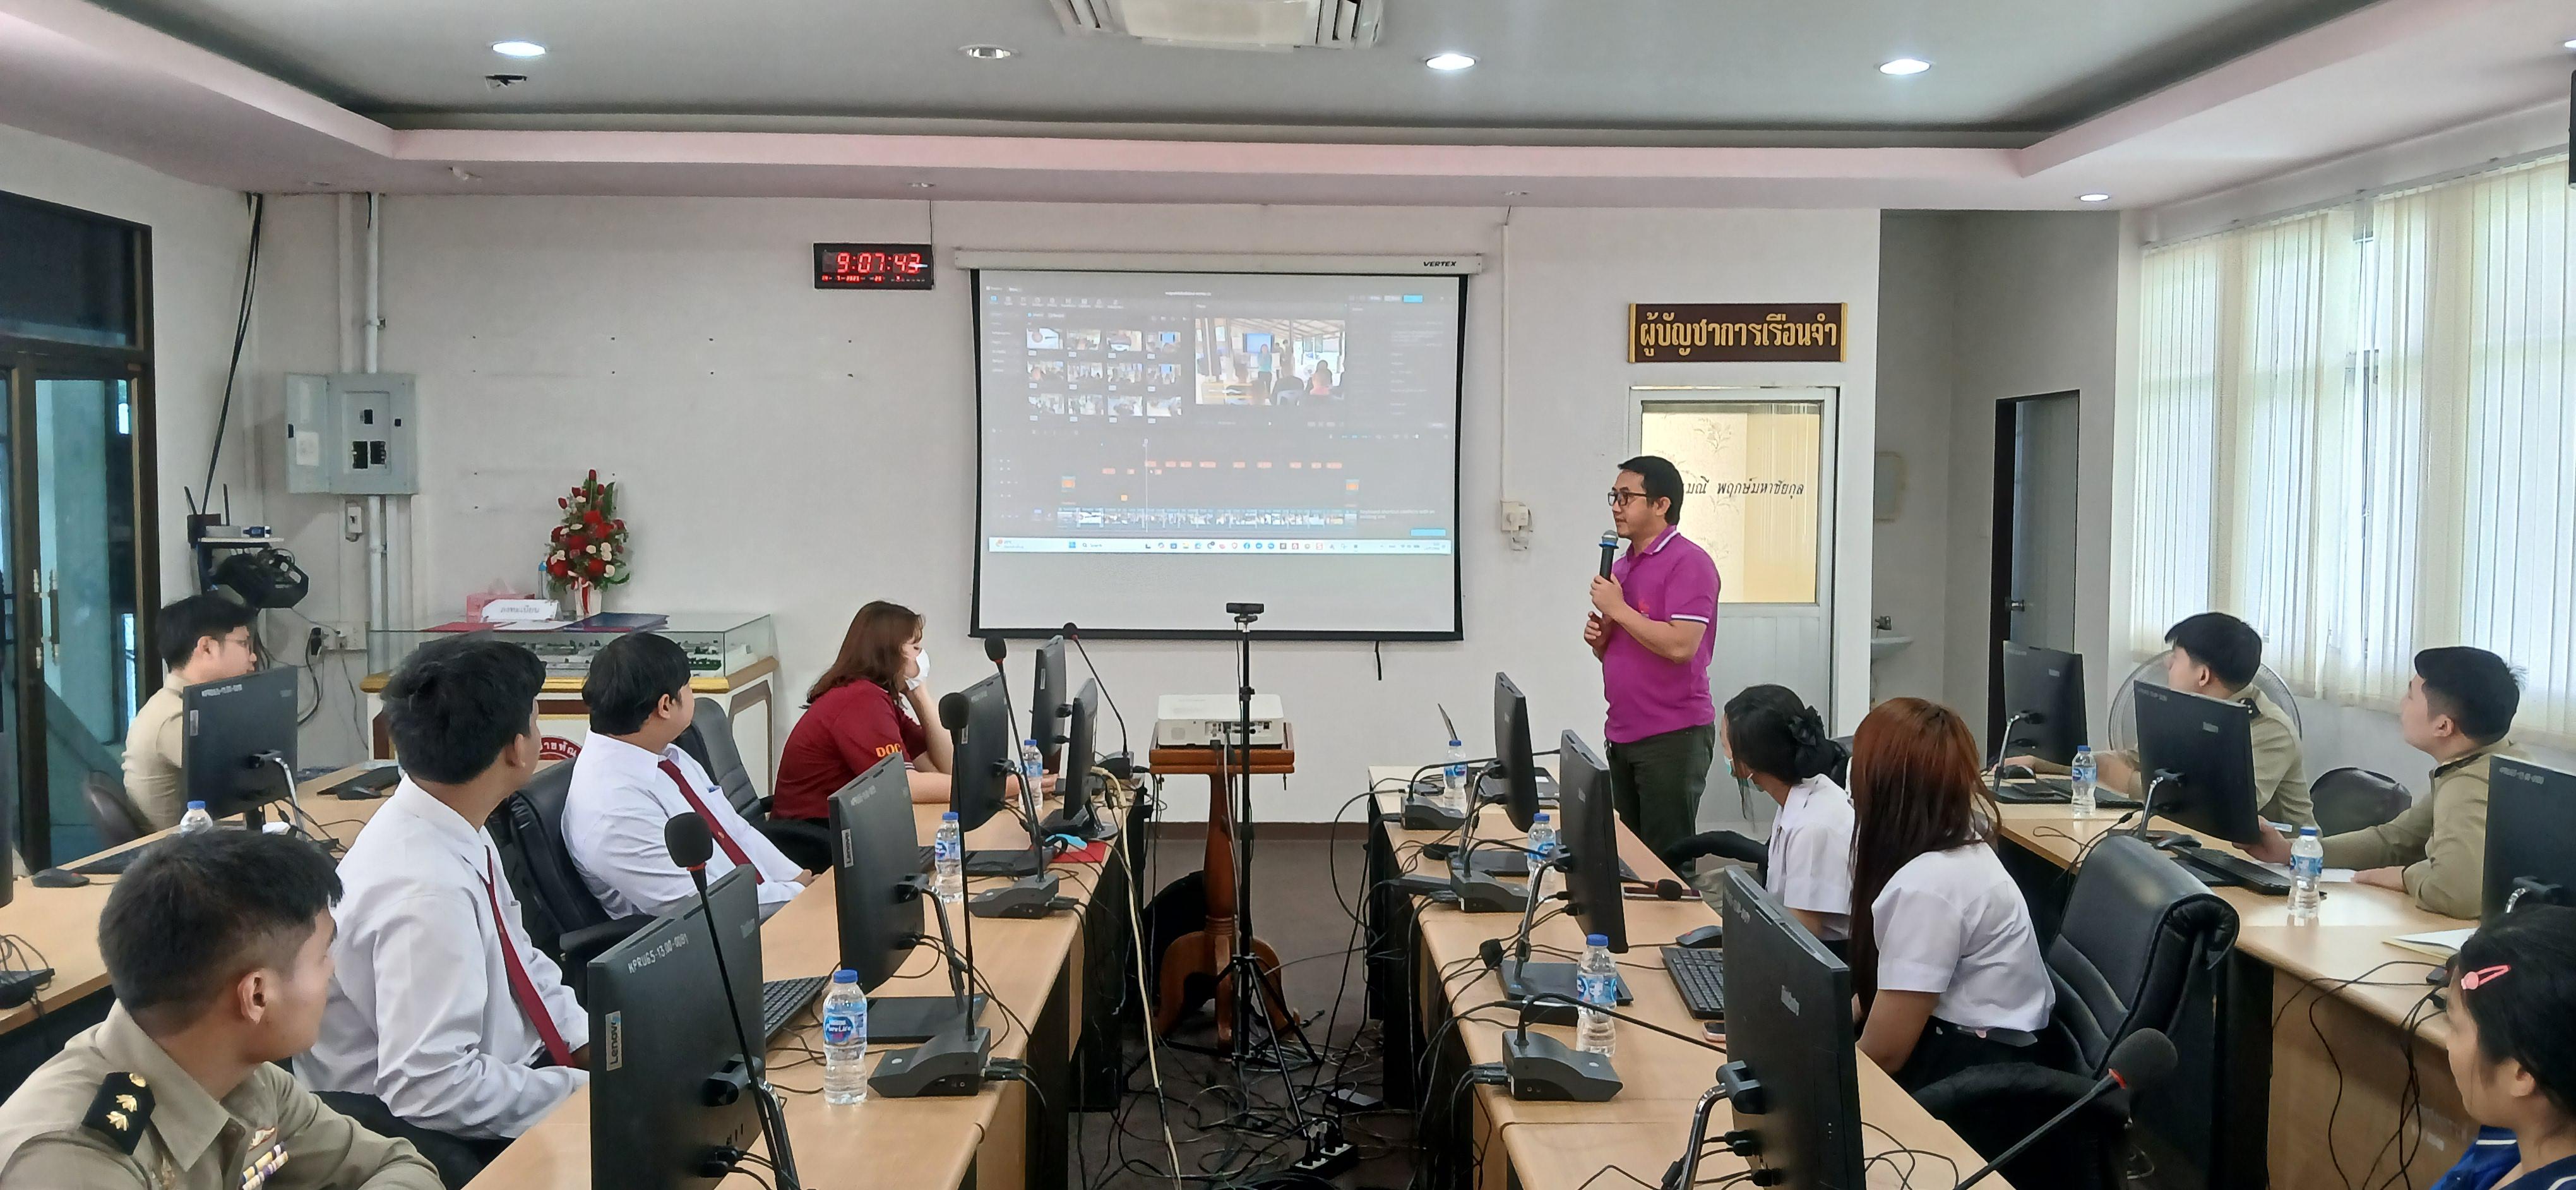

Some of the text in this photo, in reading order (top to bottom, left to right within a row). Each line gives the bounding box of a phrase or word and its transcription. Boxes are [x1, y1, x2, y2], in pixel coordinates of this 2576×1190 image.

[837, 252, 921, 273] 9:07:43
[1640, 312, 1837, 356] ผู้บัญชาการเรือนจำ
[1683, 475, 1710, 495] มณี
